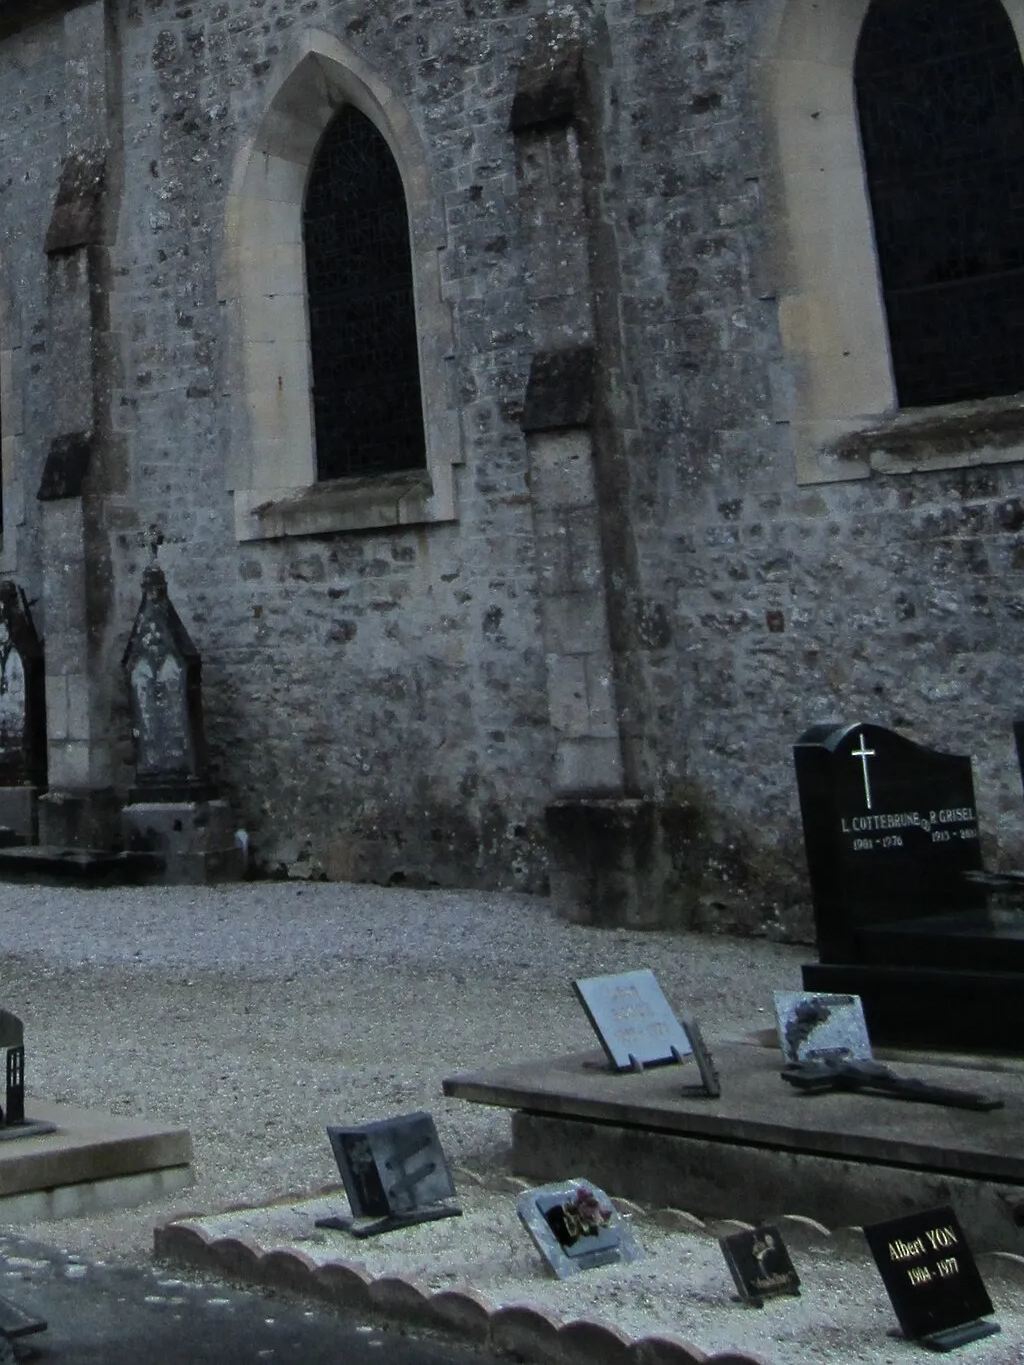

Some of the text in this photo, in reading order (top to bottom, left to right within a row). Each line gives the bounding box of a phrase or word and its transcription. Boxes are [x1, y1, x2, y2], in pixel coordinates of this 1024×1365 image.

[852, 811, 921, 832] COTTEBRUNE
[939, 807, 976, 824] GRISEL
[887, 1224, 959, 1261] Albert YON
